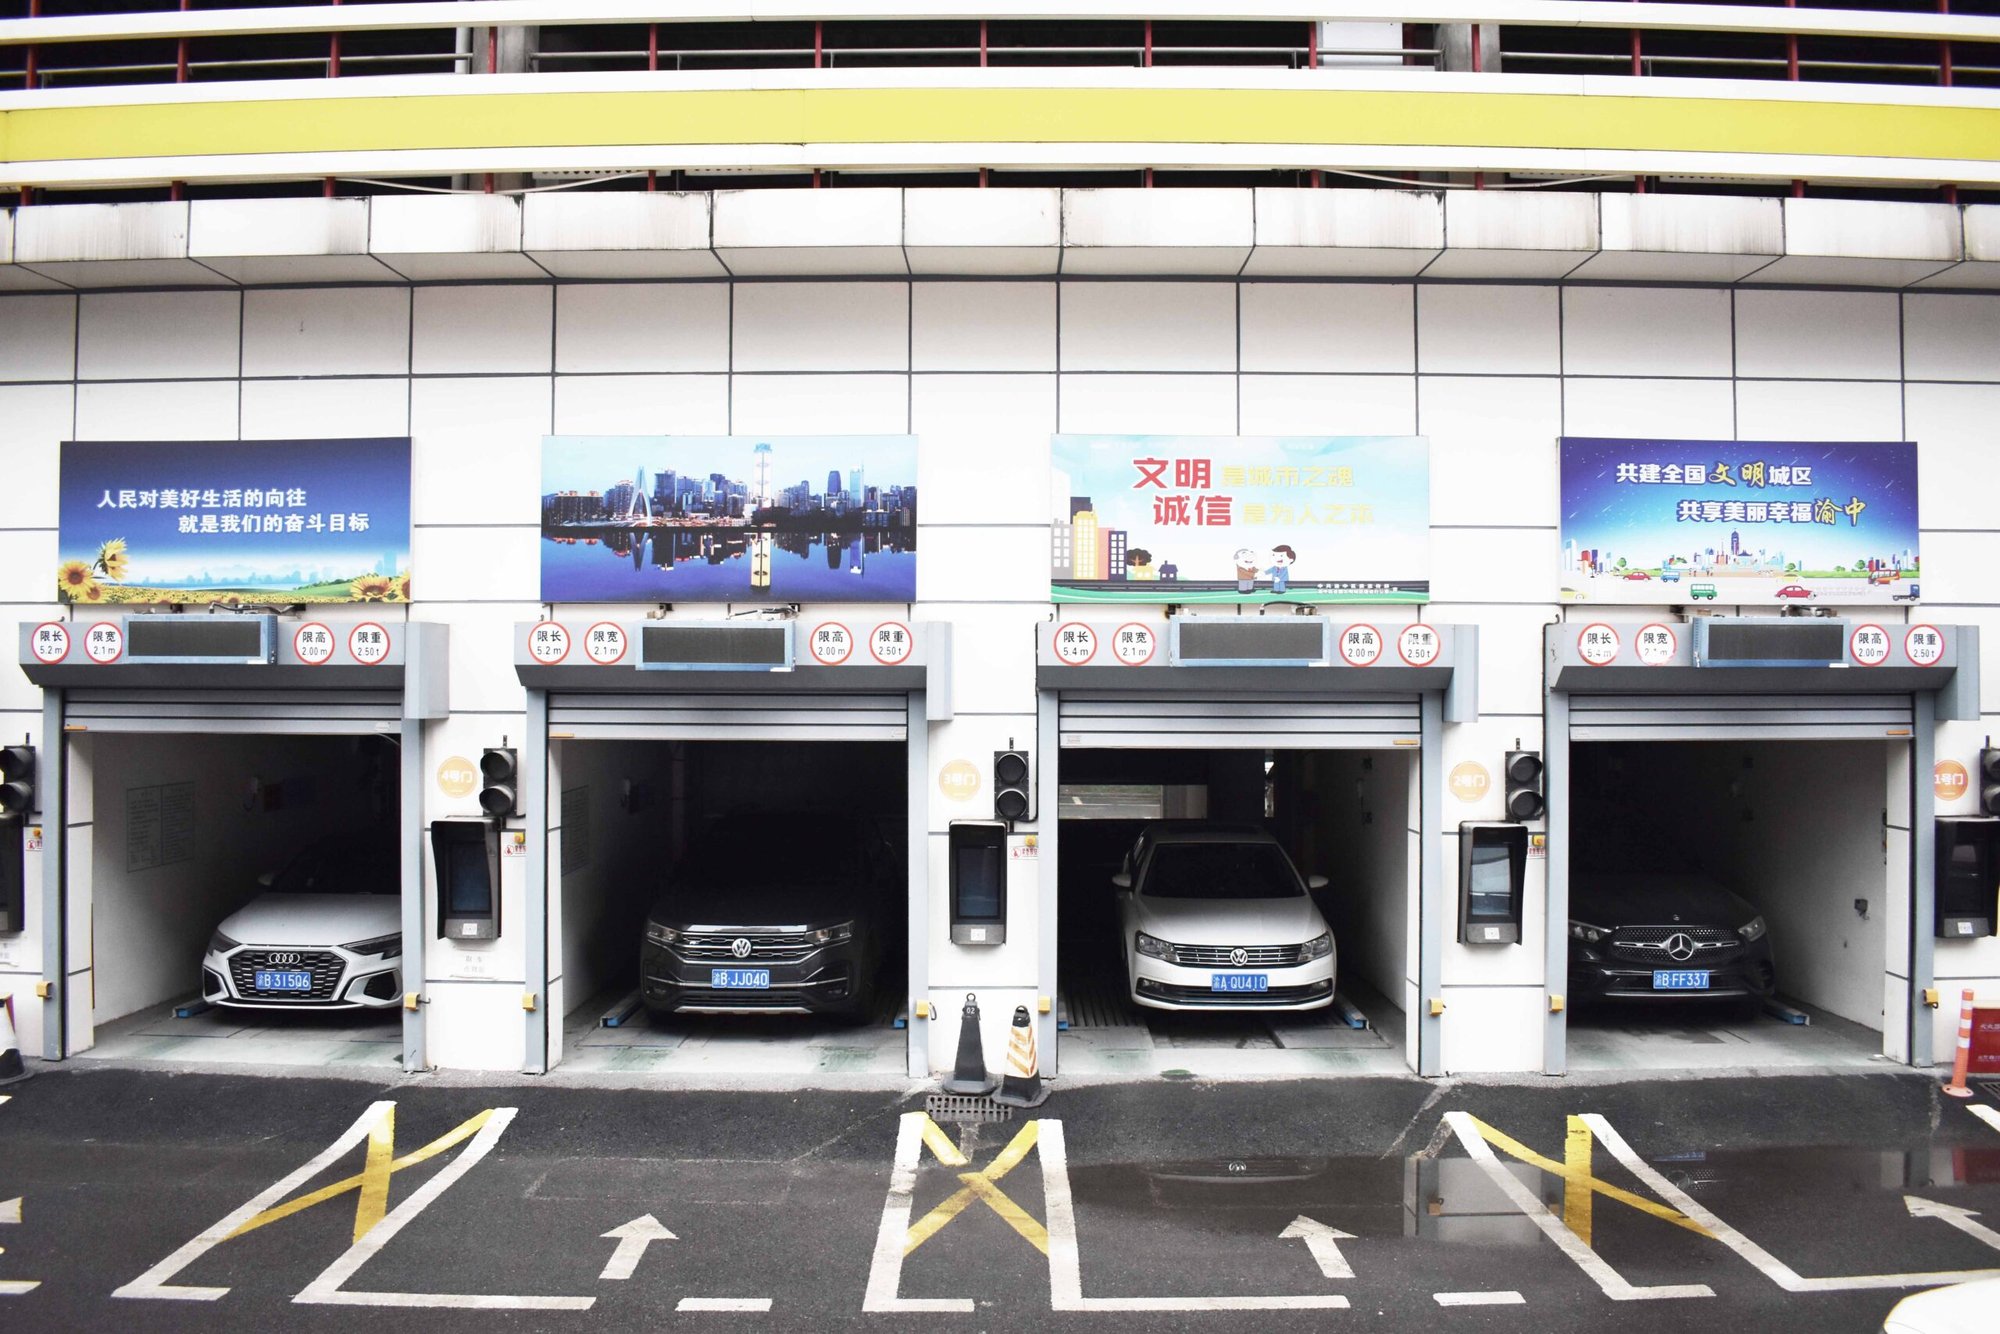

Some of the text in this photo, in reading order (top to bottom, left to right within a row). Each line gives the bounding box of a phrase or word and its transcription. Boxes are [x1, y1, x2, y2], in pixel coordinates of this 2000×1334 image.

[1133, 458, 1211, 488] 文明
[1616, 462, 1813, 487] 共建全国文明城区
[97, 488, 307, 508] 人民对美好生活的向往
[1153, 495, 1232, 526] 诚信
[1679, 497, 1867, 526] 共享美丽幸福渝中
[178, 513, 370, 533] 就是我们的奋斗目标
[40, 631, 62, 642] 限长
[93, 631, 116, 642] 限宽
[302, 631, 326, 643] 限高
[358, 631, 381, 644] 限重
[537, 630, 562, 642] 限长
[594, 630, 618, 642] 限宽
[818, 630, 844, 642] 限高
[879, 630, 904, 642] 限重
[1064, 631, 1088, 642] 限长
[1122, 632, 1147, 644] 限宽
[1348, 632, 1373, 644] 限高
[1587, 632, 1612, 644] 限长
[1644, 632, 1668, 644] 限宽
[1858, 632, 1882, 644] 限高
[1914, 634, 1936, 646] 限重
